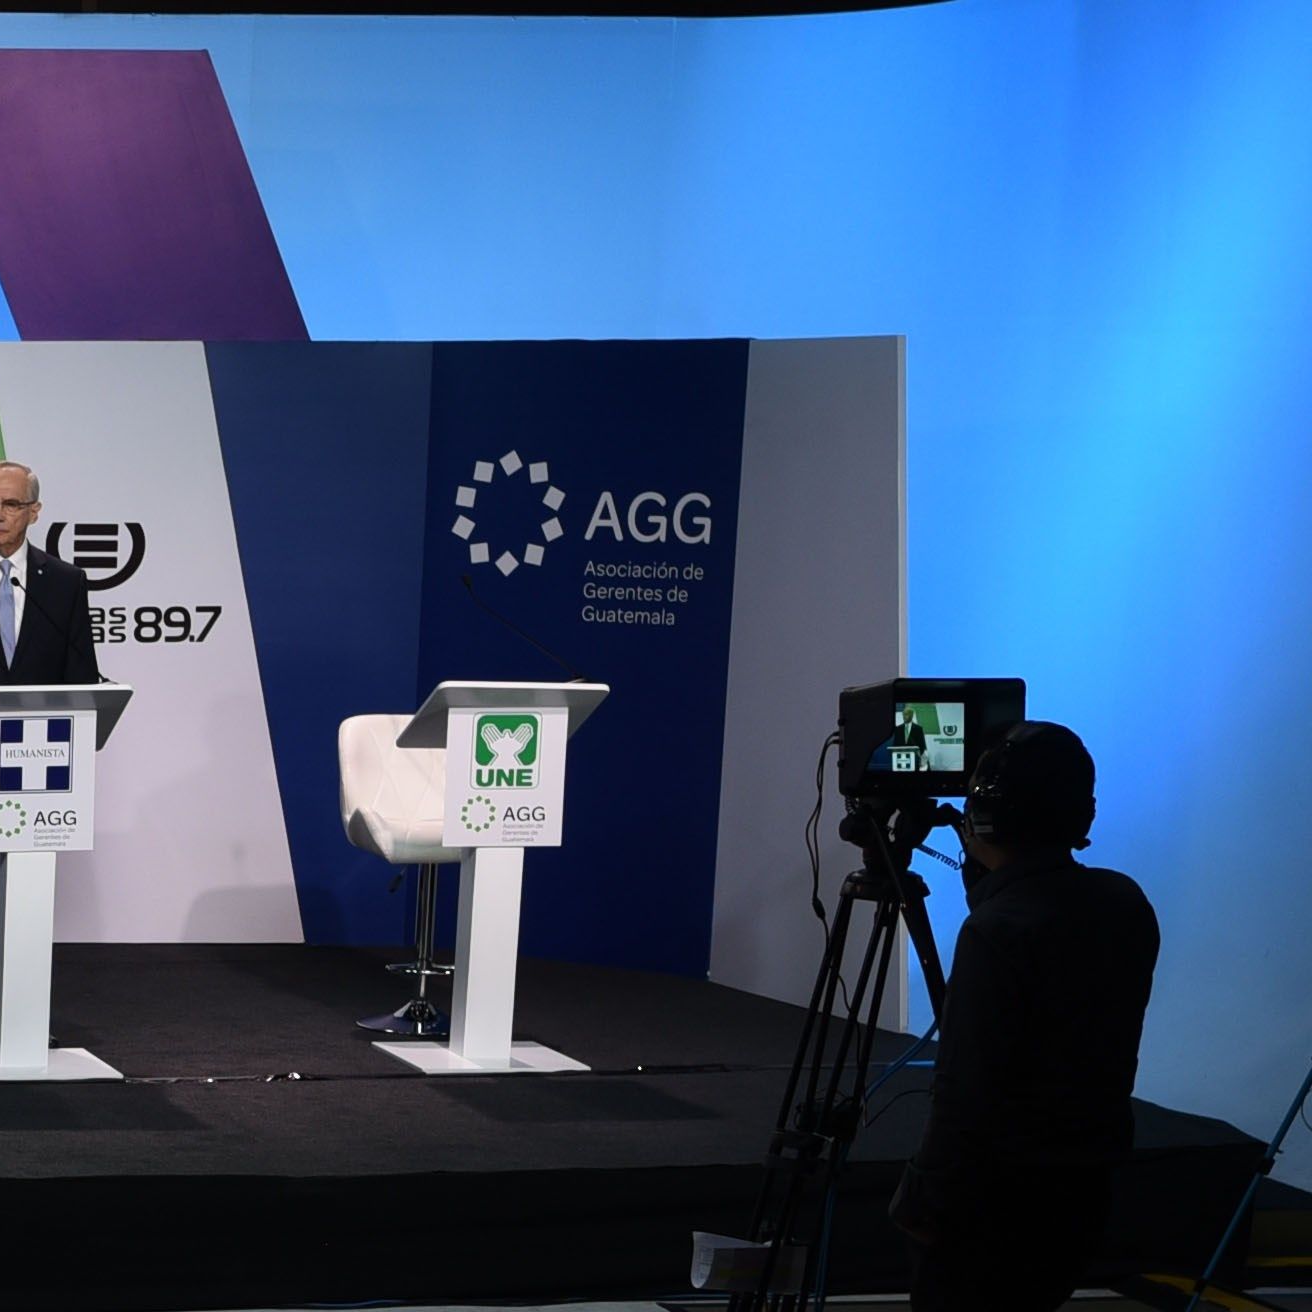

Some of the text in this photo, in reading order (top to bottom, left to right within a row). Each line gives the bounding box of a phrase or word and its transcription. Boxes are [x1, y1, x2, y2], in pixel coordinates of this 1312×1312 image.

[584, 491, 712, 544] AGG
[584, 560, 704, 580] Asociación de
[583, 582, 688, 602] Gerentes de
[133, 605, 222, 643] 89.7
[581, 605, 675, 625] Guatemala
[5, 749, 65, 759] HUMANISTA
[476, 769, 533, 787] UNE
[33, 810, 77, 826] AGG
[503, 806, 545, 821] AGG
